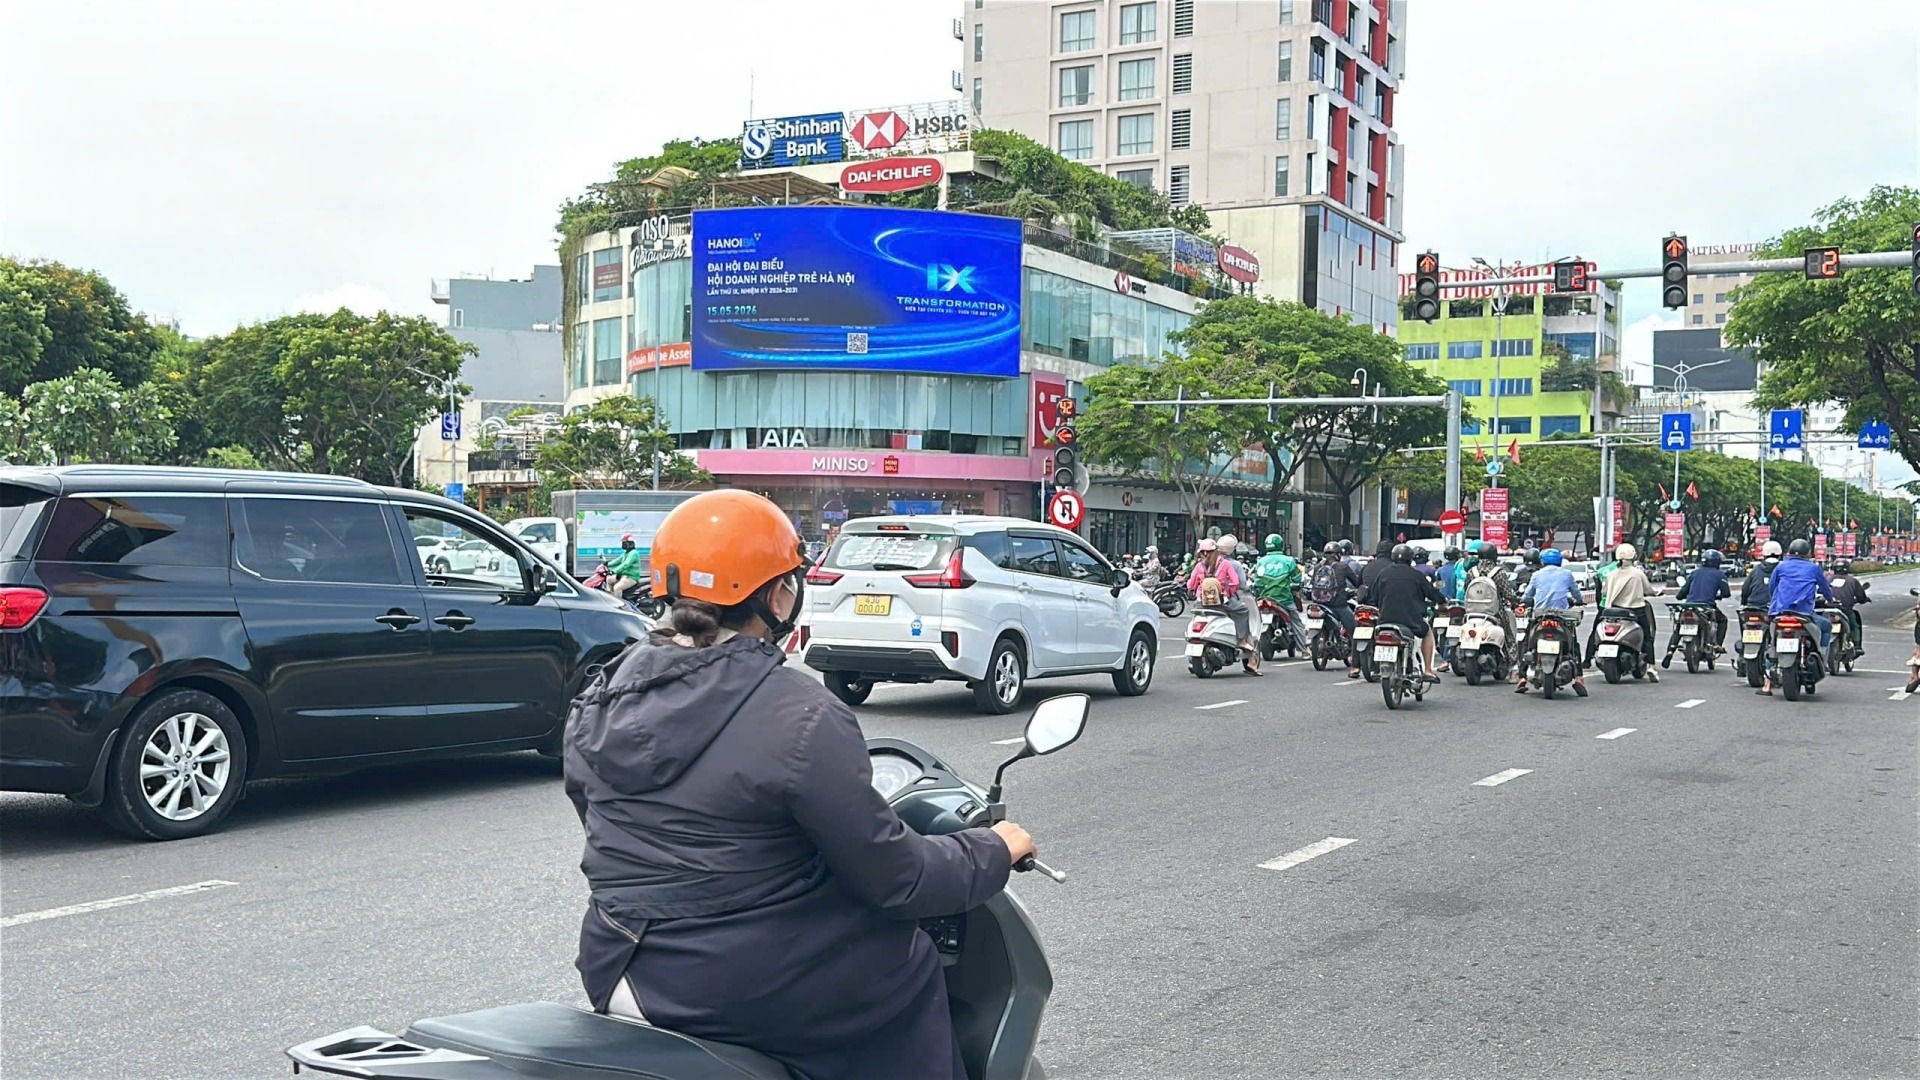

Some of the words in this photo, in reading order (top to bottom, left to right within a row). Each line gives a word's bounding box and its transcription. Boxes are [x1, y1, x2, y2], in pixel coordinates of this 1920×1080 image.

[775, 118, 841, 139] Shinhan
[914, 114, 968, 135] HSBC
[787, 137, 828, 158] Bank
[848, 168, 902, 184] DAI-ICHI
[903, 164, 932, 178] LIFE
[725, 260, 741, 273] HỘI
[743, 261, 759, 273] ĐẠI
[761, 257, 784, 271] BIỂU
[1821, 250, 1839, 277] 2
[707, 273, 723, 287] HỘI
[725, 274, 757, 285] DOANH
[760, 272, 796, 286] NGHIỆP
[799, 271, 818, 283] TRẺ
[820, 271, 834, 283] HÀ
[837, 271, 855, 286] NỘI
[927, 263, 977, 294] IX
[1571, 265, 1585, 288] 2
[707, 305, 757, 316] 15.05.2026
[896, 296, 1005, 311] TRANSFORMATION
[668, 349, 691, 361] Asse
[1059, 401, 1073, 415] 42
[762, 429, 809, 448] AIA
[812, 457, 868, 472] MINISO
